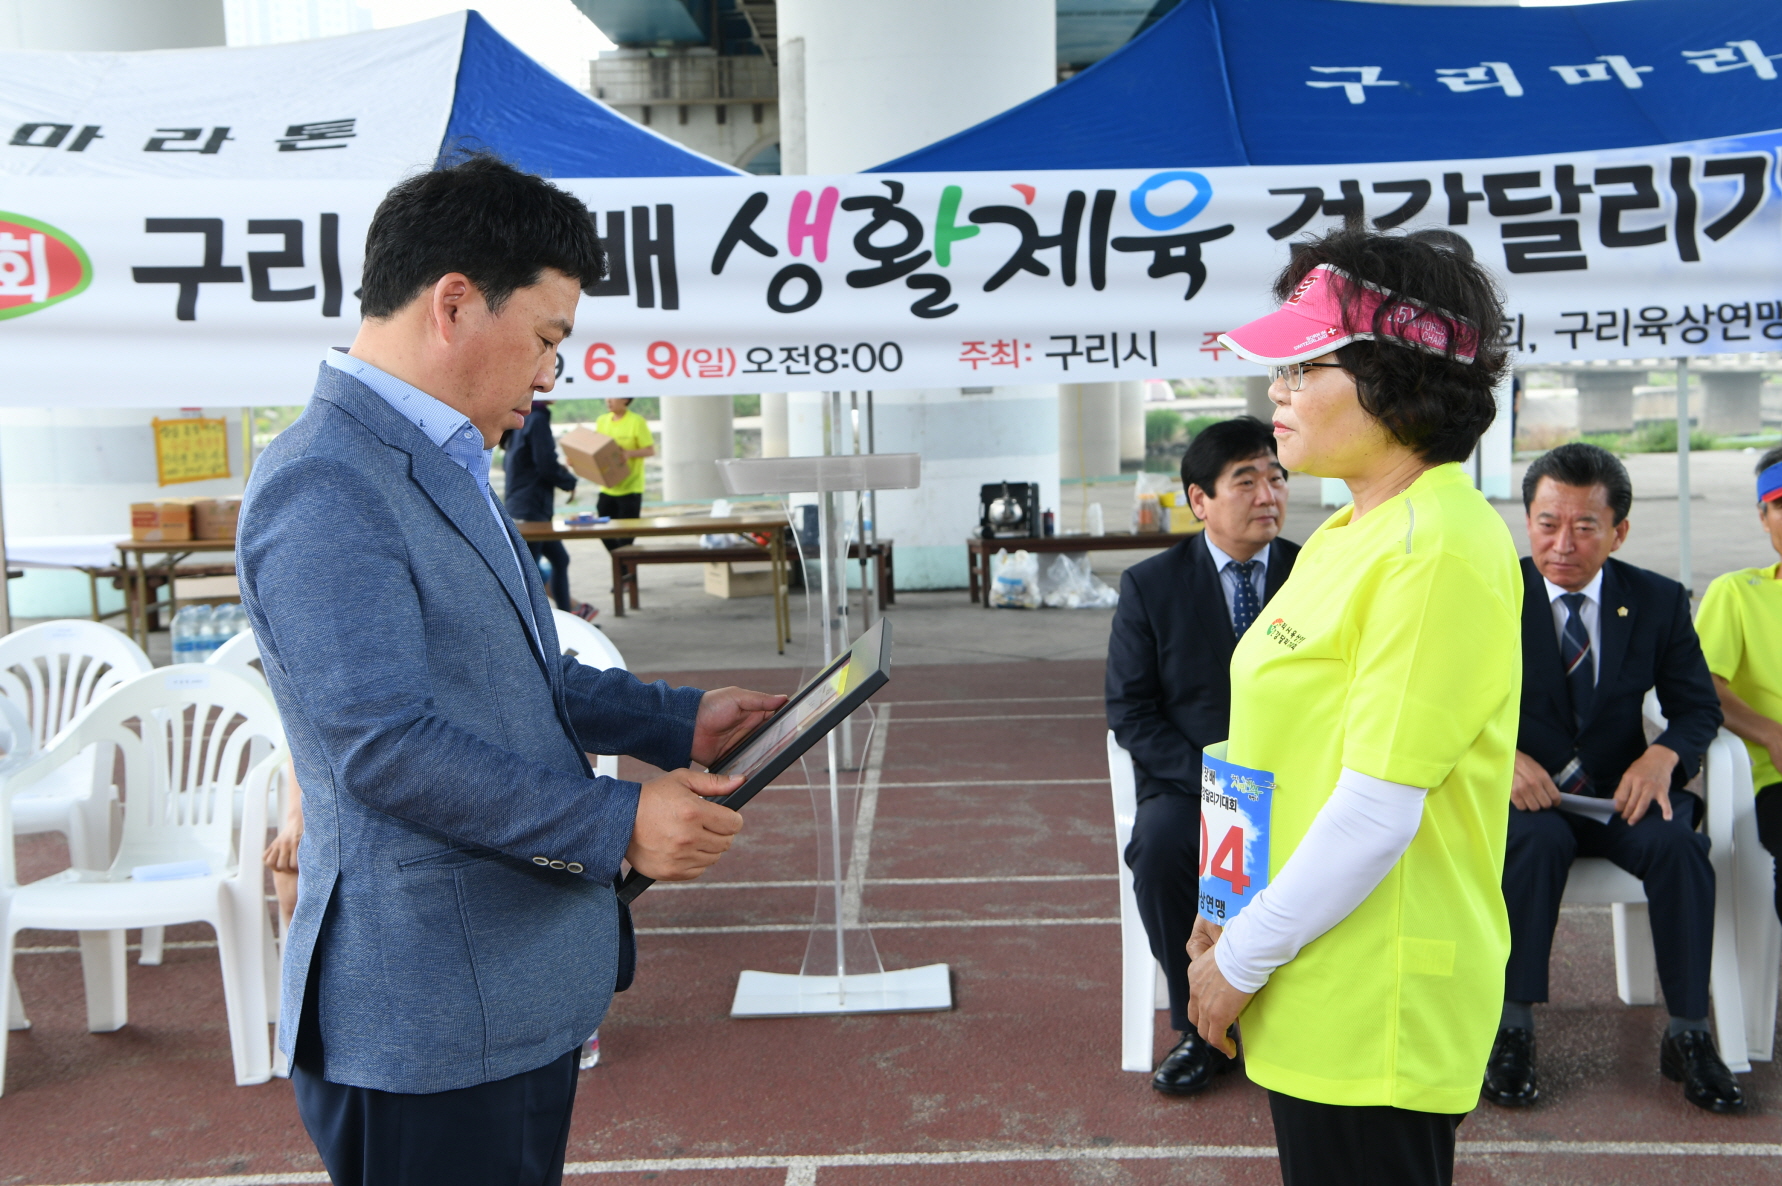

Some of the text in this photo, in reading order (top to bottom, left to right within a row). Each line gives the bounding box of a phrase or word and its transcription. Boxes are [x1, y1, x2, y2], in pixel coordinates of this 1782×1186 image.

[711, 170, 1234, 318] 생활체육
[958, 339, 1032, 371] 주최:
[1045, 330, 1158, 371] 구리시
[1293, 333, 1328, 351] SWITZERLAND
